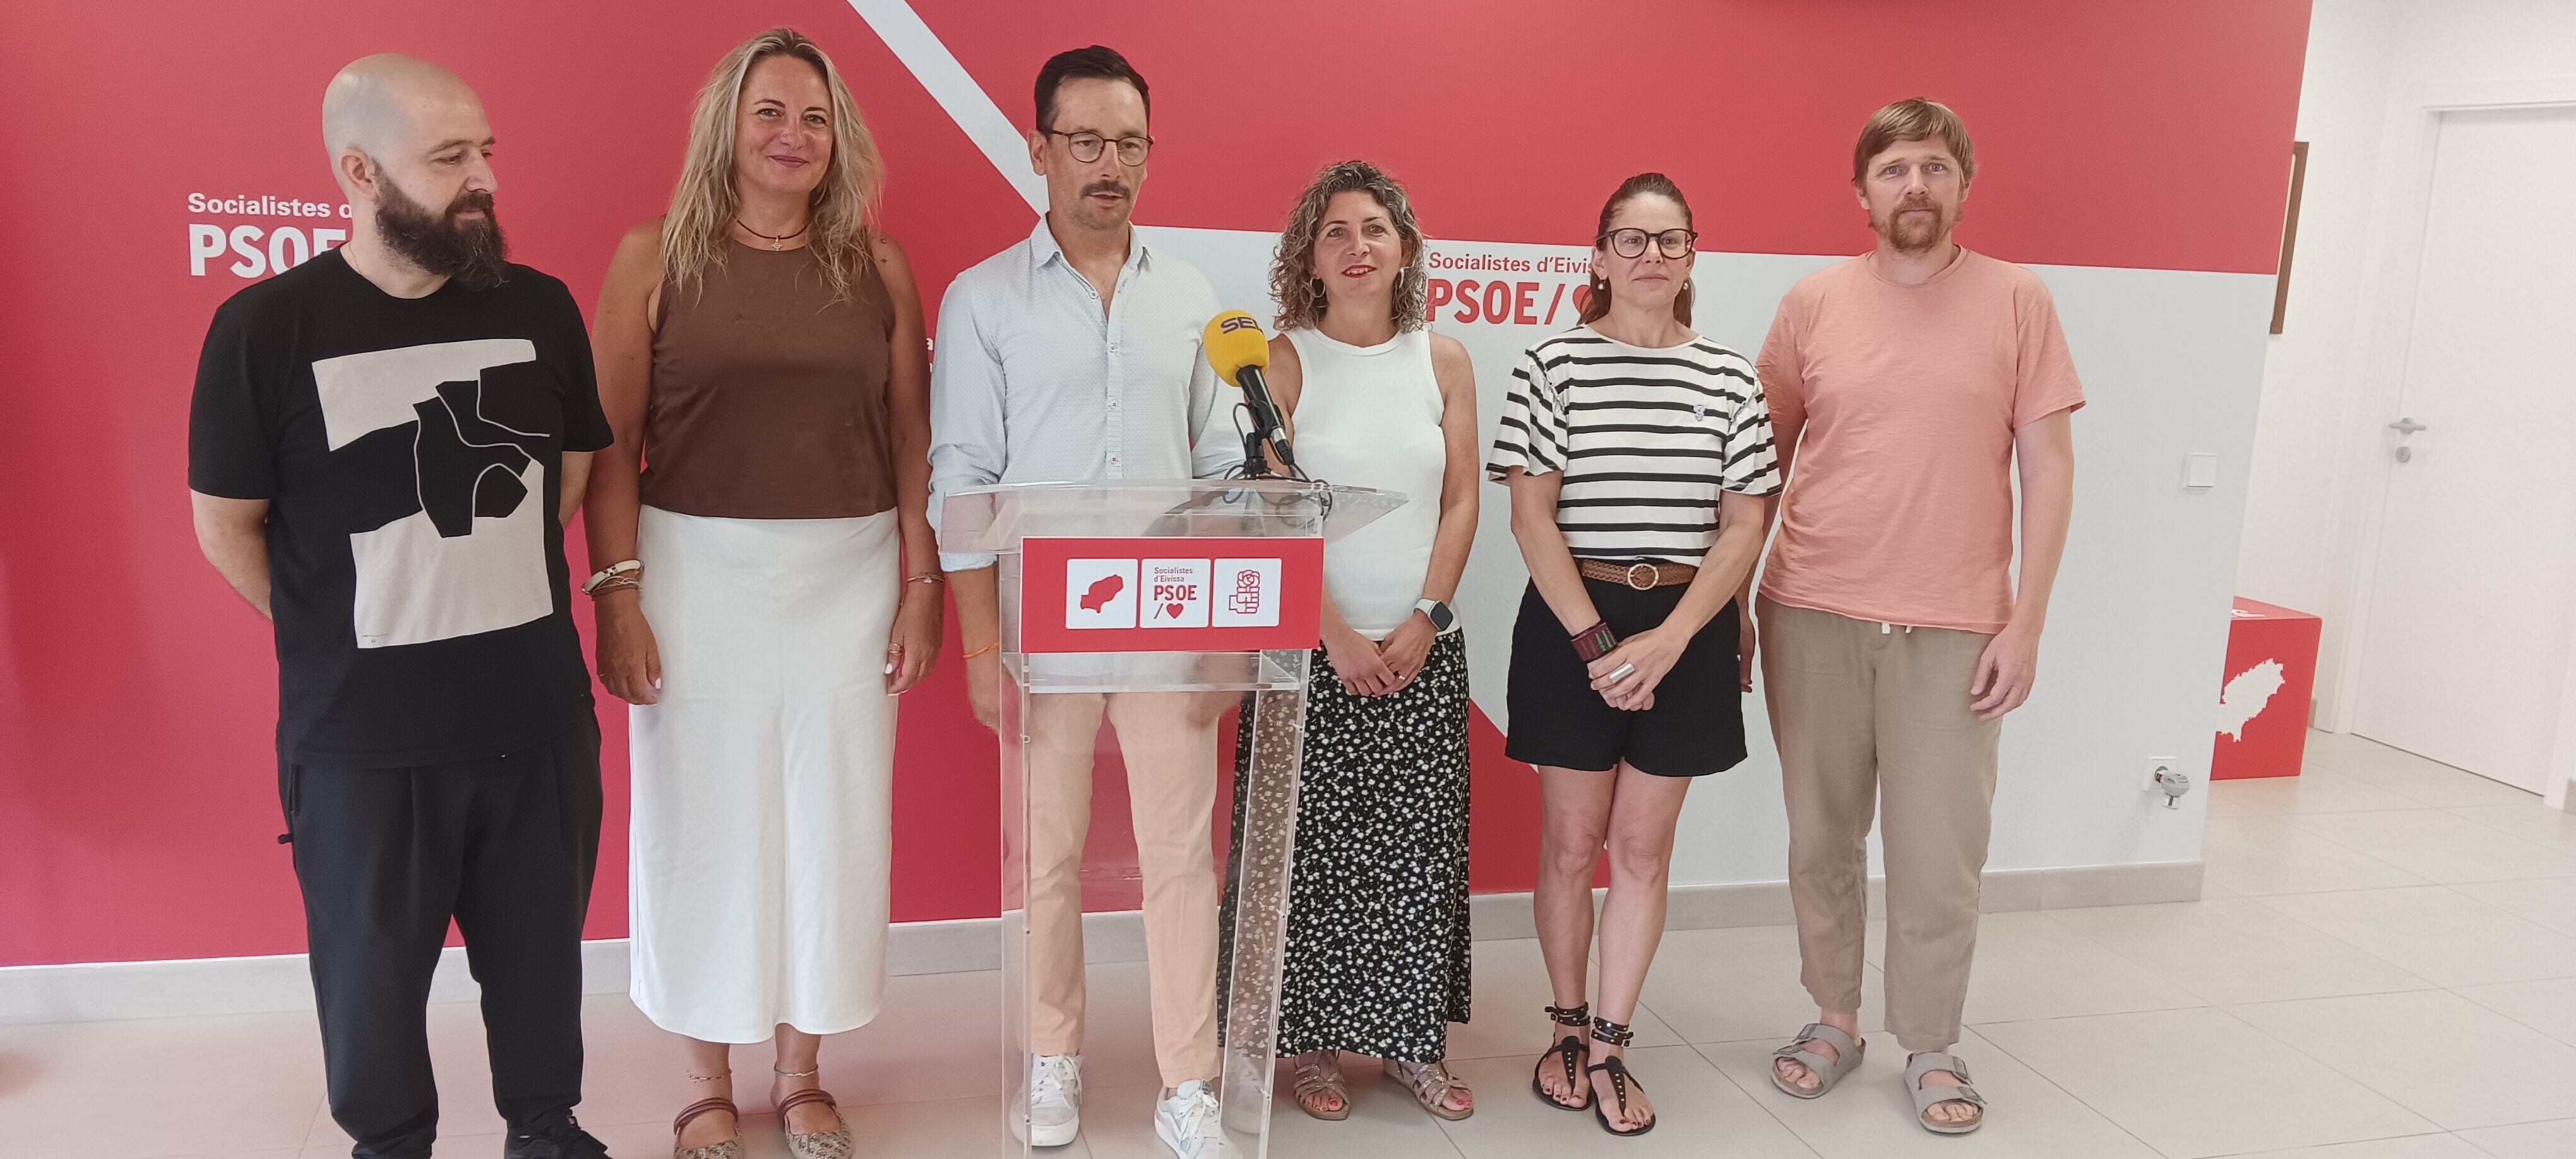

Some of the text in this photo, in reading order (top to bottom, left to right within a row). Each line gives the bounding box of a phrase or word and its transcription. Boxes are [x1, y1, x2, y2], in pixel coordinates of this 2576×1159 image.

[188, 192, 331, 218] Socialistes
[1428, 252, 1531, 272] Socialistes
[1220, 316, 1264, 335] SE
[1154, 566, 1193, 574] Socialistes
[1154, 585, 1197, 601] PSOE
